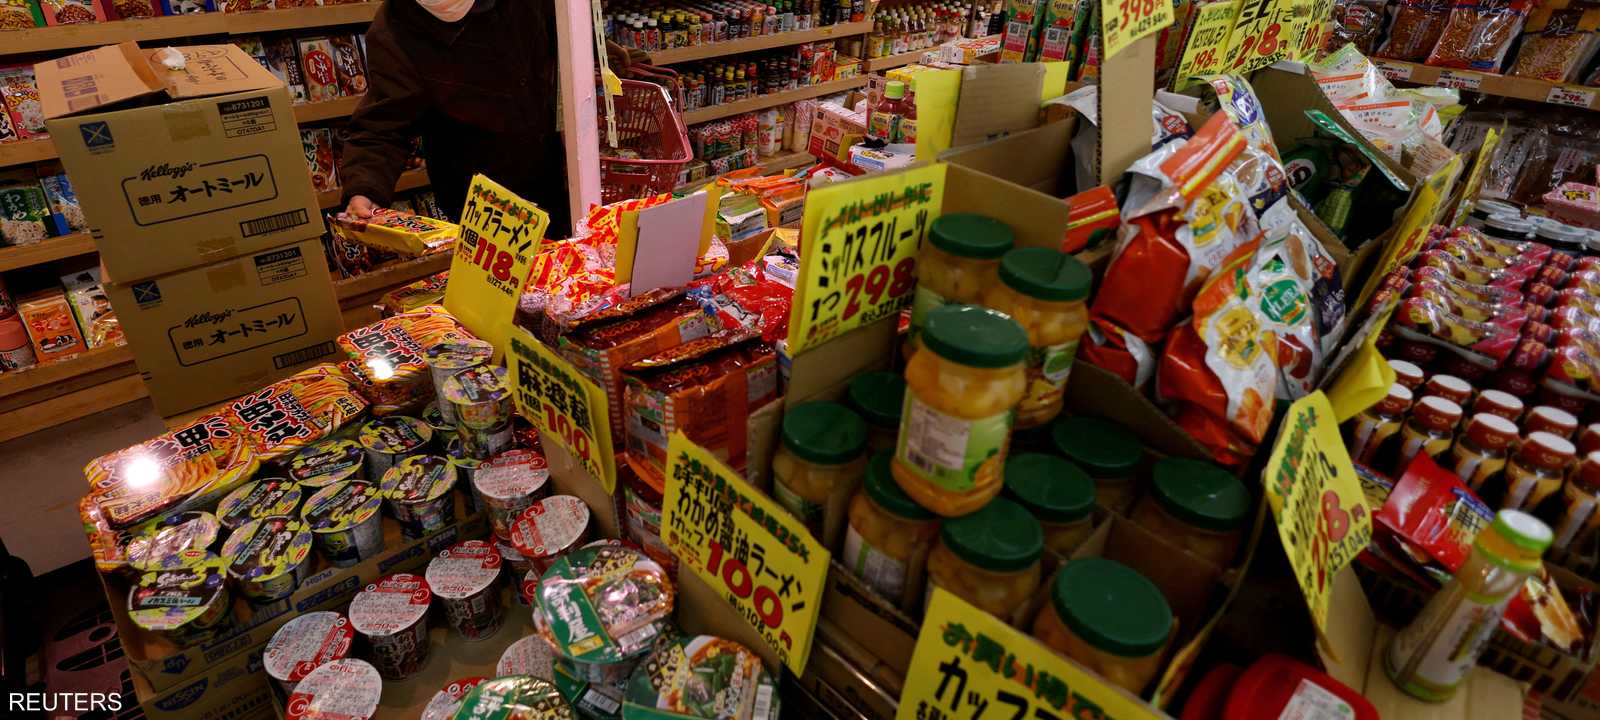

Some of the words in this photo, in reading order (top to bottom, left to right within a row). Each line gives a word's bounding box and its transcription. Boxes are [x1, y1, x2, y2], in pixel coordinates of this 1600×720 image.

[141, 161, 195, 181] Kellogg's
[168, 172, 264, 204] オートミール
[464, 197, 532, 253] カップラーメン
[819, 210, 928, 288] ミックスフルーツ
[473, 236, 514, 281] 118
[812, 291, 841, 321] 1つ
[842, 257, 916, 321] 298
[184, 308, 235, 328] Kellogg's
[208, 312, 296, 346] オートミール
[232, 387, 312, 444] 油そば
[543, 403, 590, 460] 100
[677, 486, 806, 612] わかめ醤油ラーメン
[707, 538, 783, 629] 100
[935, 656, 1063, 720] カップ
